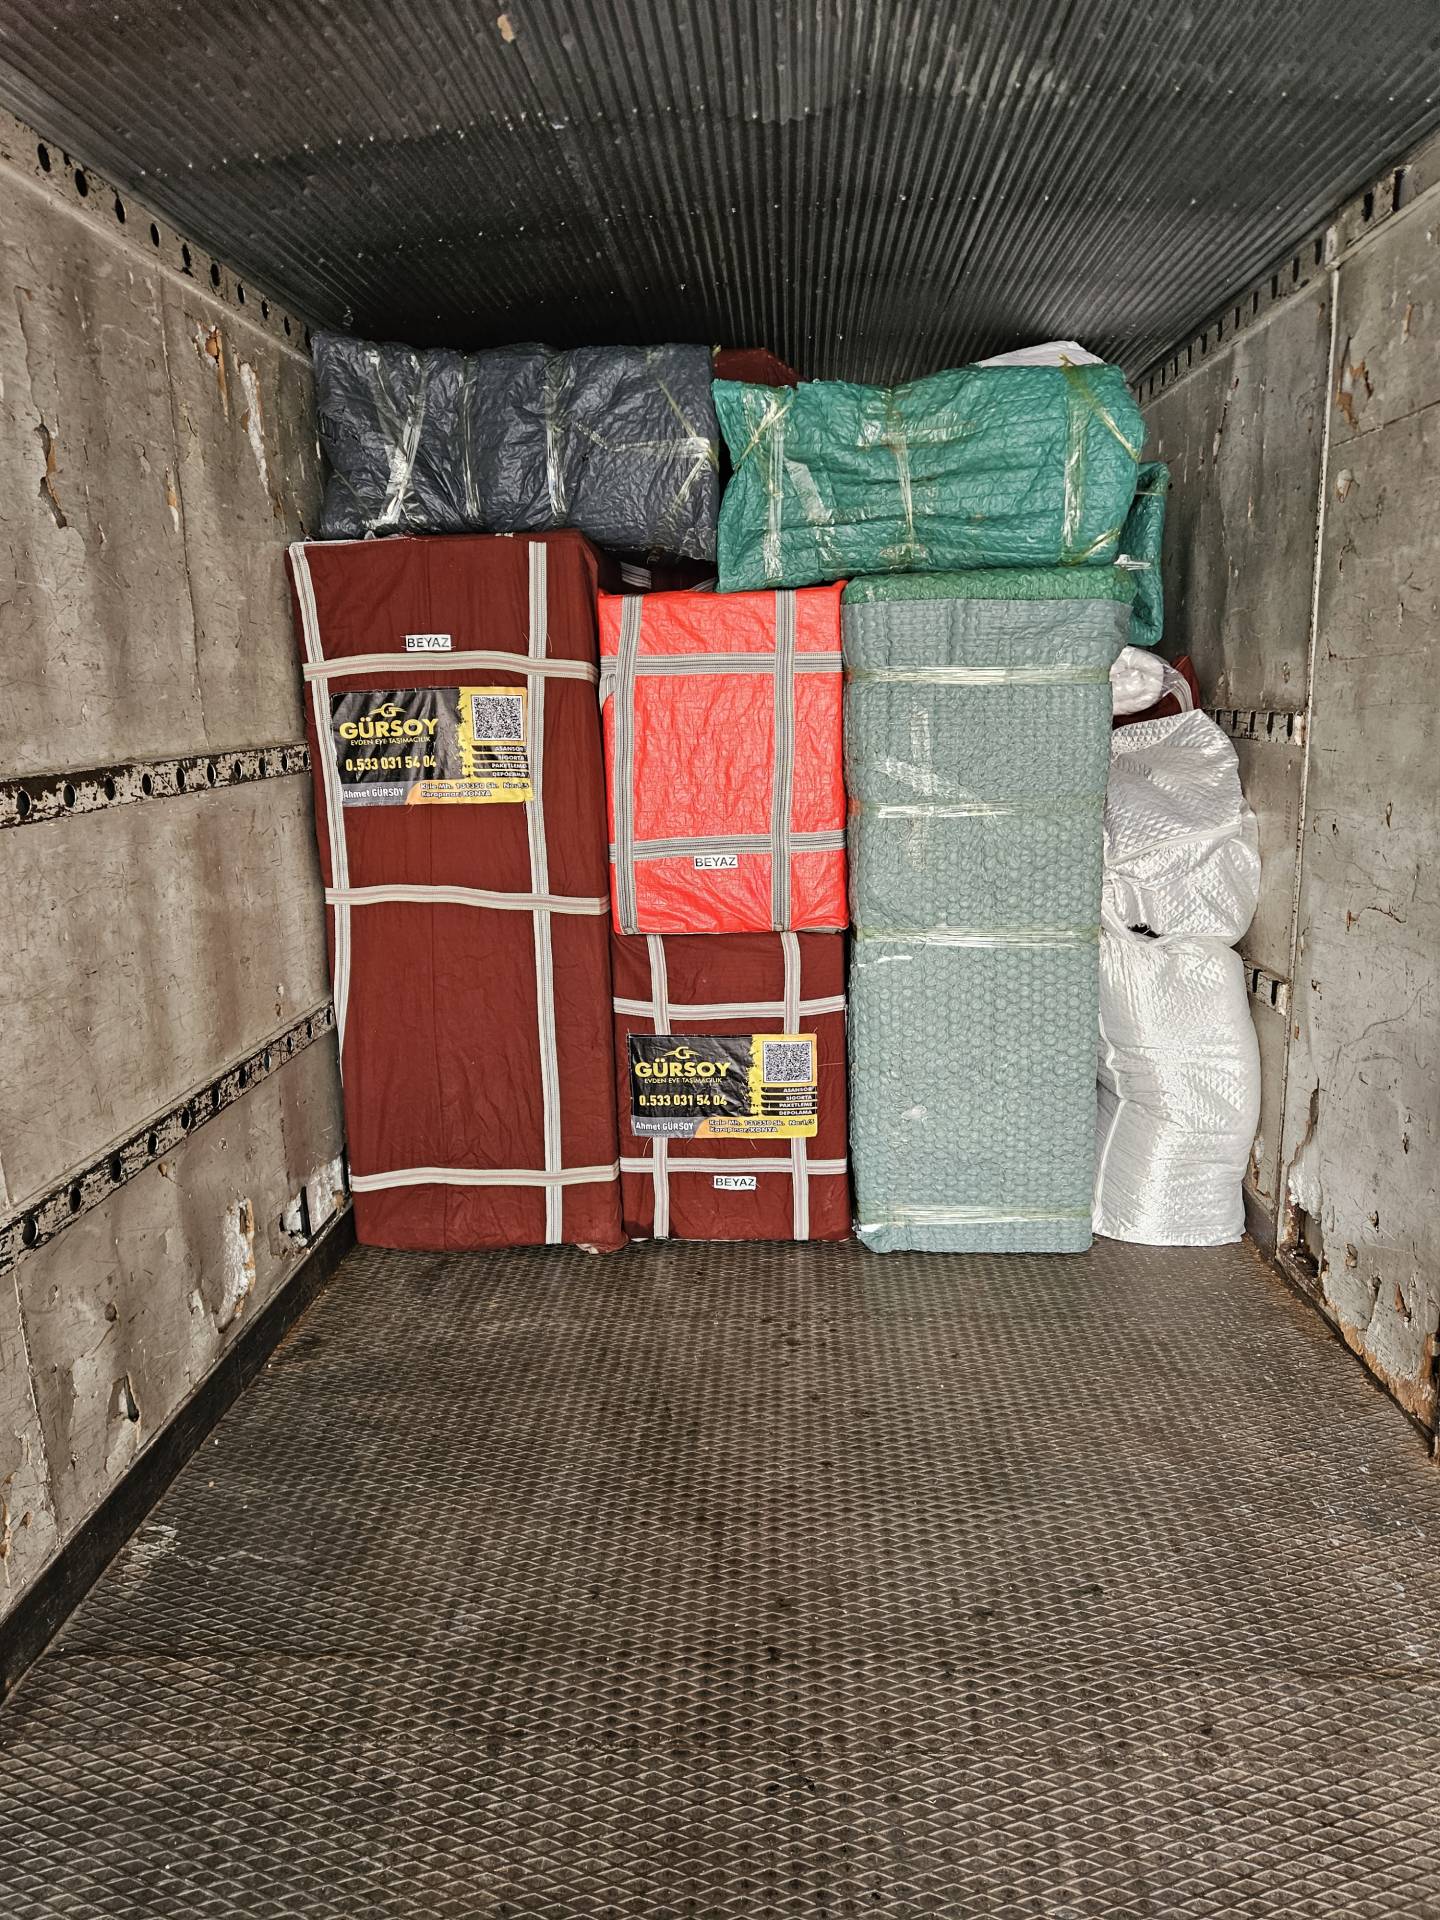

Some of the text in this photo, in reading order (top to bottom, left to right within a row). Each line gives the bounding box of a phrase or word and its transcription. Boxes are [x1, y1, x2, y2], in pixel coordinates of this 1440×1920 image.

[407, 637, 450, 648] BEYAZ
[339, 716, 439, 739] GÜRSOY
[388, 737, 431, 745] TAŞIMACILIK
[345, 754, 437, 771] 0.533 031 54 04
[343, 786, 404, 799] Ahmet GÜRSOY
[695, 857, 736, 867] BEYAZ
[634, 1057, 732, 1078] GÜRSOY
[681, 1077, 722, 1085] TAŞIMACILIK
[639, 1094, 728, 1106] 0.533 031 54 04
[635, 1121, 694, 1131] Ahmet GÜRSOY
[715, 1177, 755, 1187] BEYAZ
